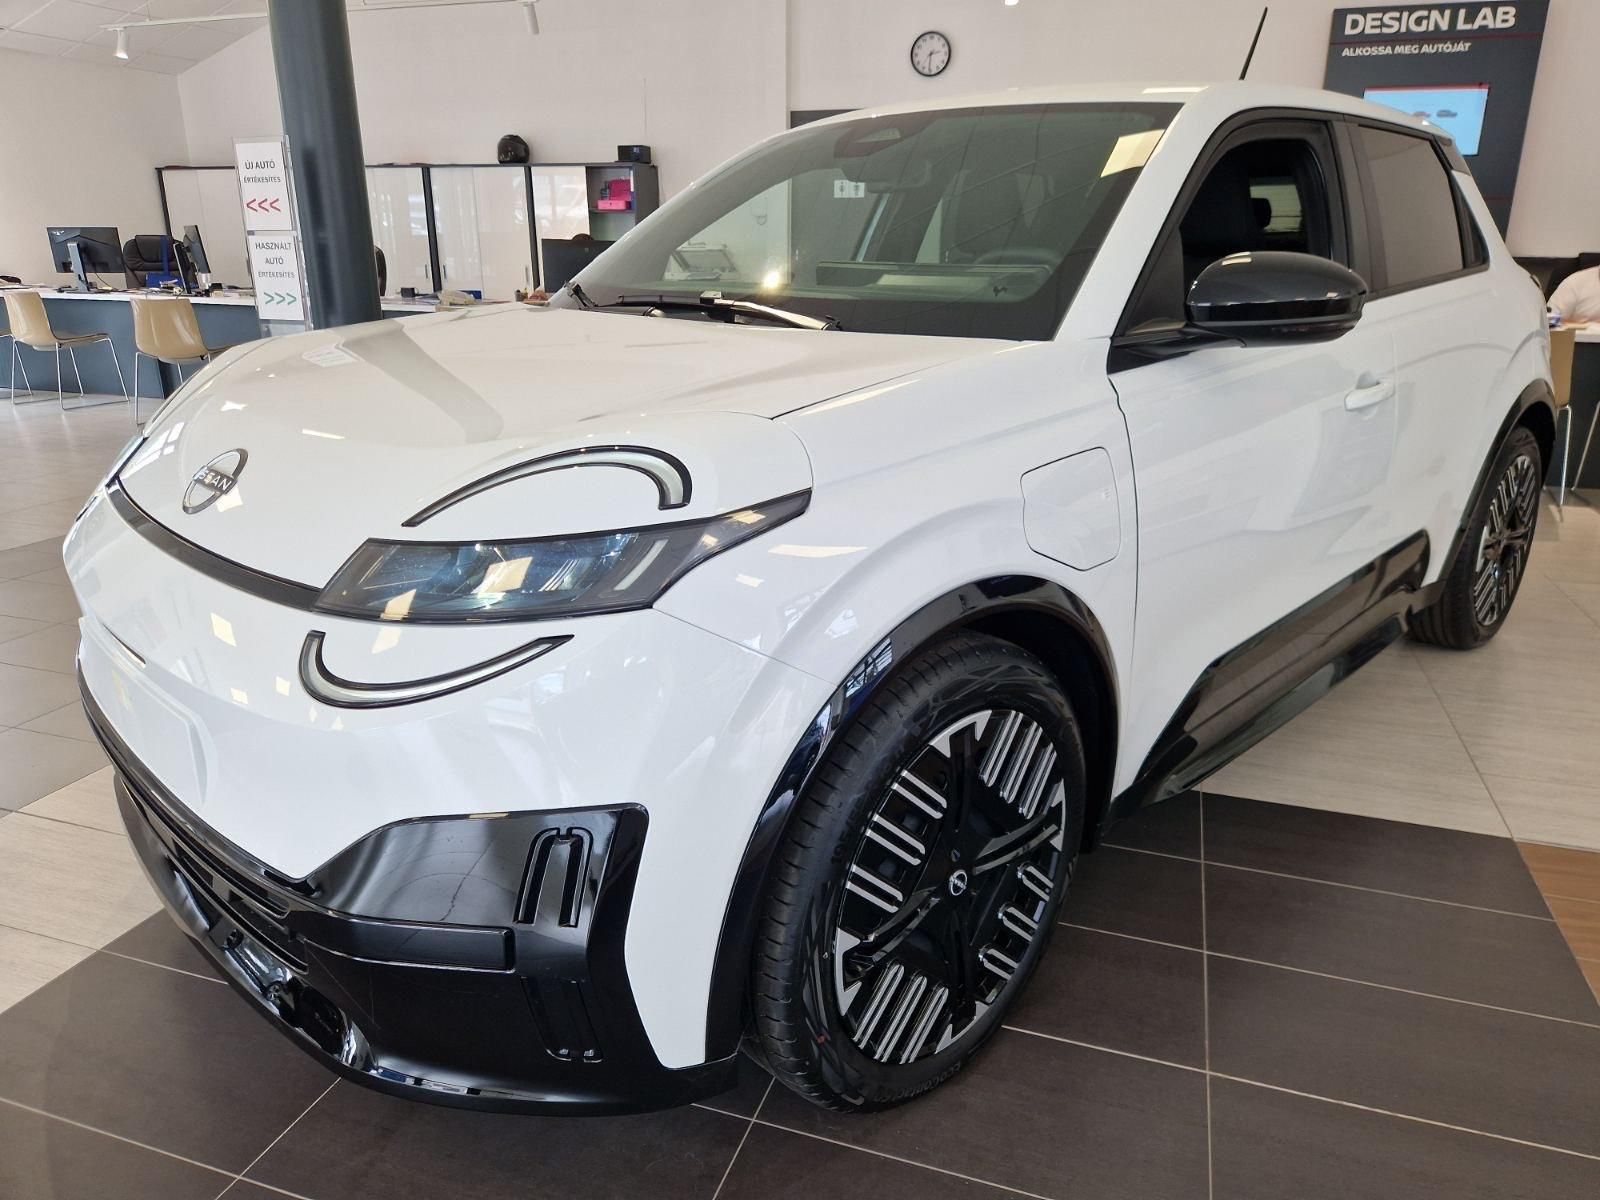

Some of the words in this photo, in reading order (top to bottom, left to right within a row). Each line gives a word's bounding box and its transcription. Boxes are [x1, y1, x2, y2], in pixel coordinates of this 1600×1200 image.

[1344, 9, 1451, 35] DESIGN
[1456, 6, 1516, 31] LAB
[1342, 46, 1393, 57] ALKOSSA
[1394, 44, 1420, 55] MEG
[1421, 41, 1472, 53] AUTÓJÁT
[244, 159, 254, 170] ÚJ
[255, 159, 276, 169] AUTÓ
[255, 241, 292, 250] HASZNÁLT
[265, 256, 284, 265] AUTÓ
